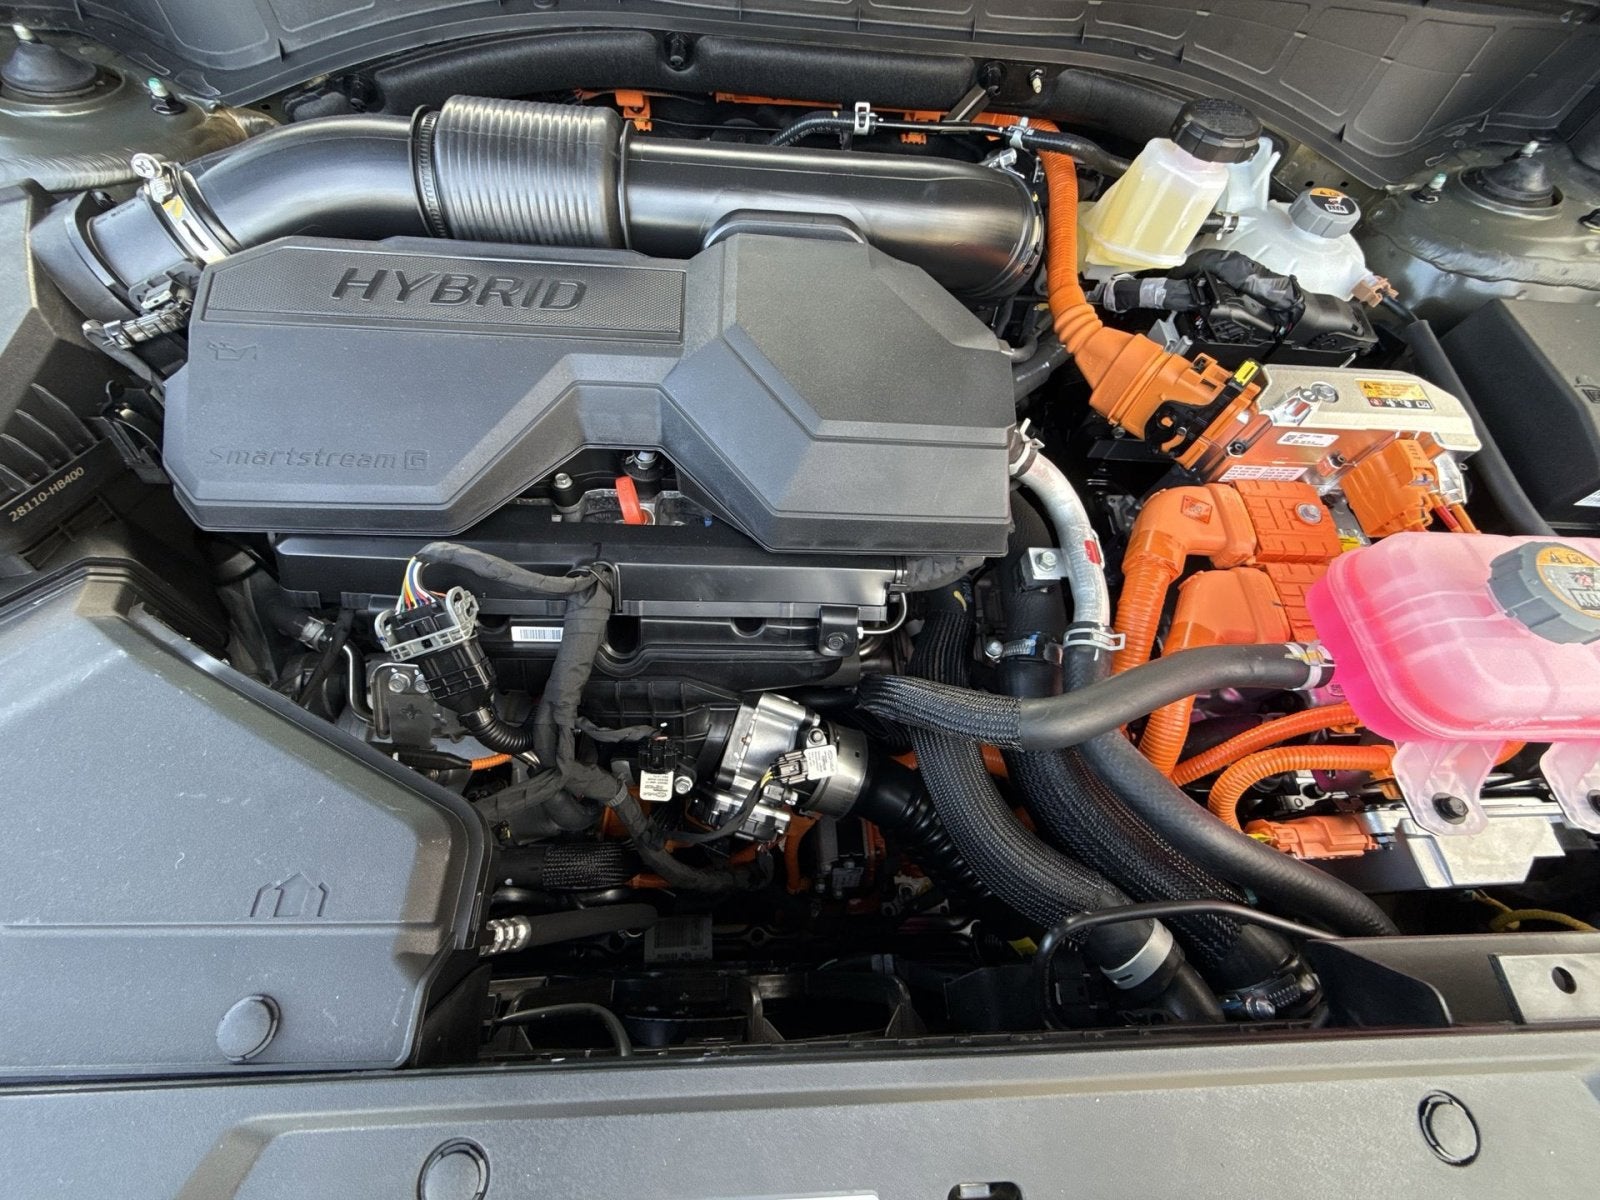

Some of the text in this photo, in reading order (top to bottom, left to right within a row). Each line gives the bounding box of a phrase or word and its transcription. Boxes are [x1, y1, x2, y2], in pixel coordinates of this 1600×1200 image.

[331, 267, 588, 311] HYBRID
[205, 447, 428, 470] Smartstream G
